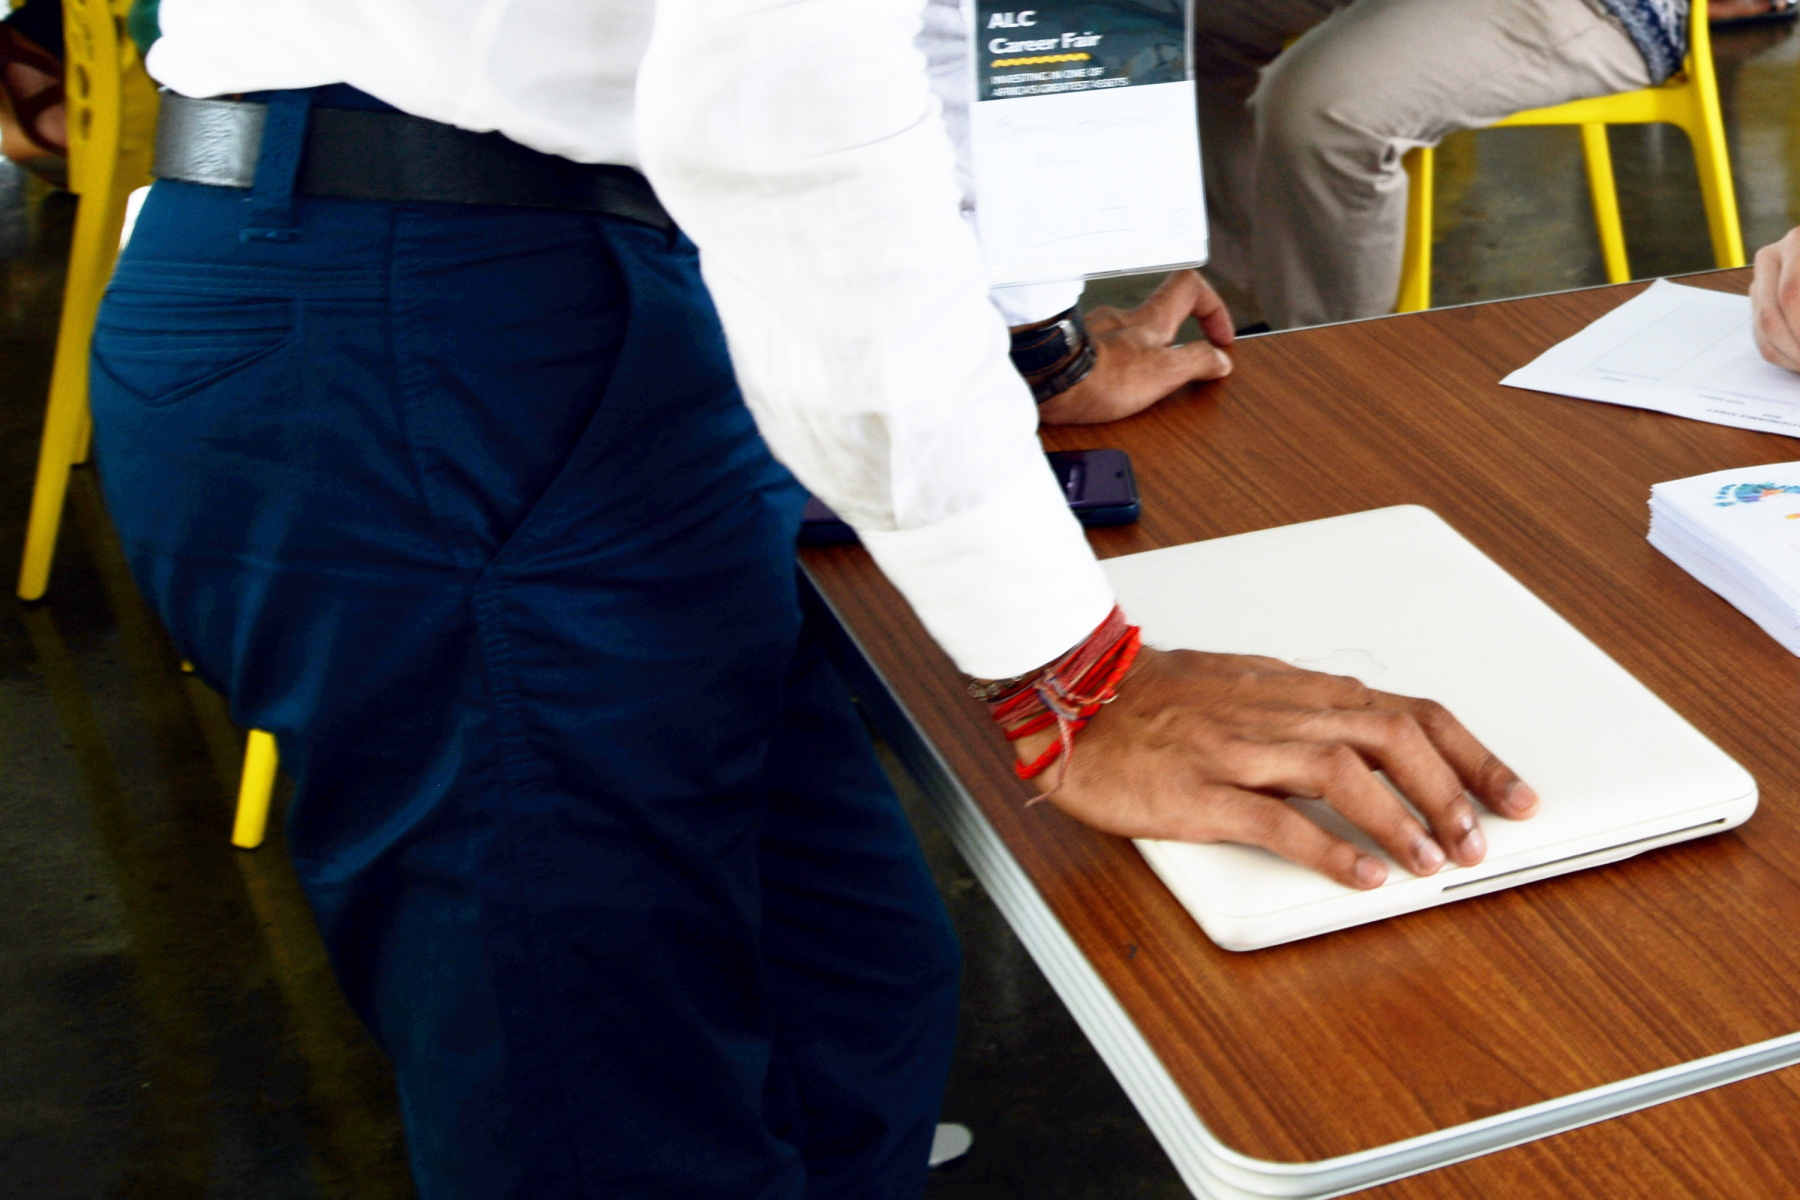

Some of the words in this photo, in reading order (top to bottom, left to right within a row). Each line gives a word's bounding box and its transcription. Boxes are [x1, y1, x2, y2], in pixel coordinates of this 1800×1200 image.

[987, 9, 1038, 29] ALC
[987, 37, 1060, 55] Career
[1061, 31, 1104, 49] Fair
